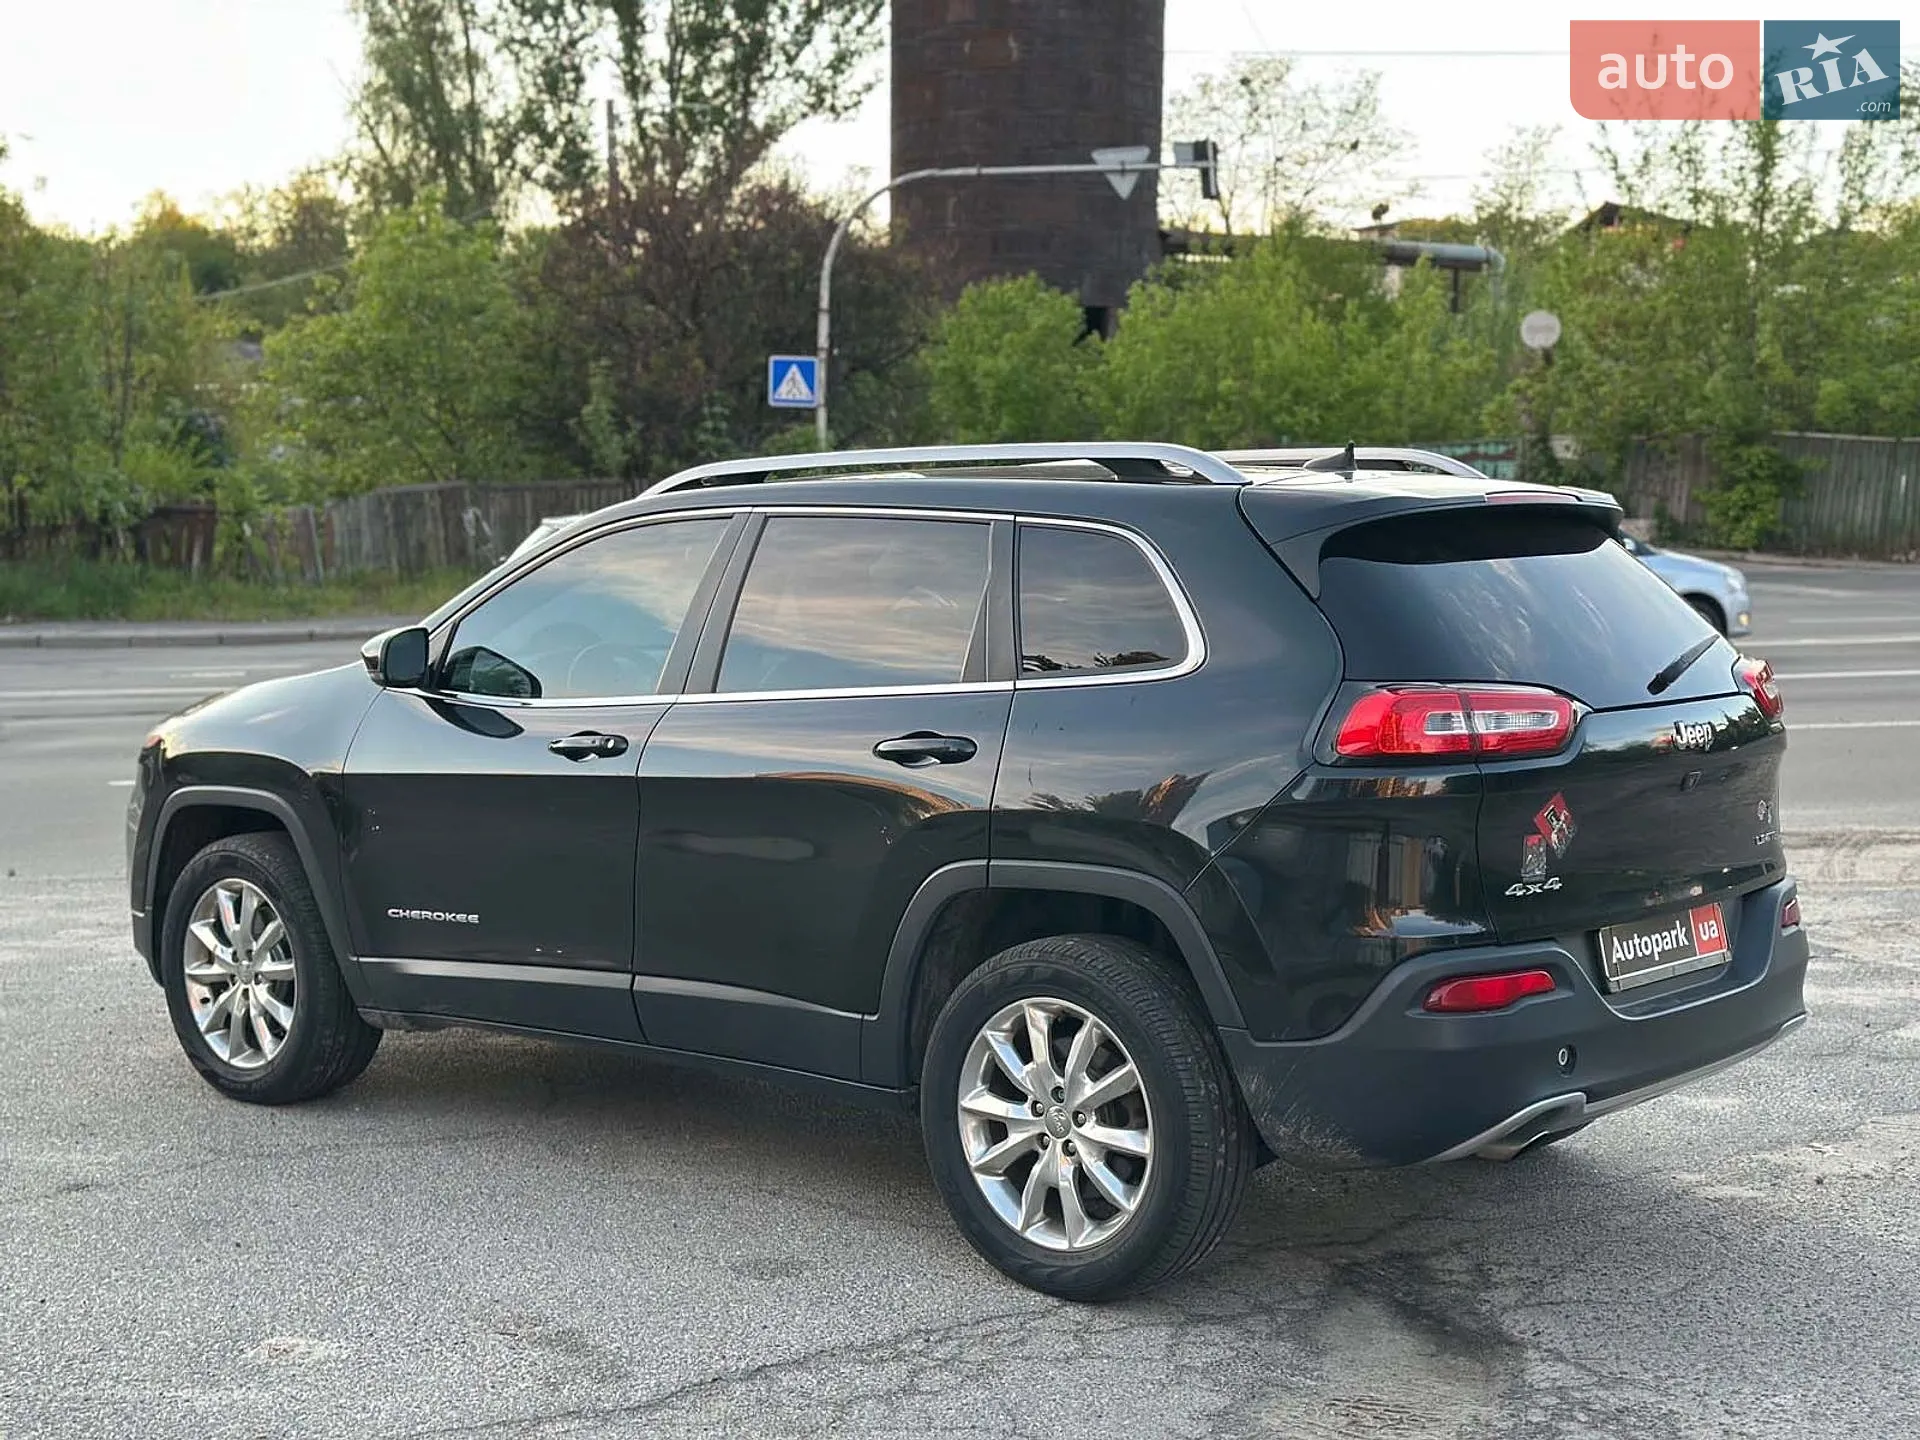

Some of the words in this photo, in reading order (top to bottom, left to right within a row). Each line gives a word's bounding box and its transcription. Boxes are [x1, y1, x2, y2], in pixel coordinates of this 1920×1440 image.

[1675, 722, 1712, 751] Jeep
[1505, 877, 1562, 896] 4x4
[387, 908, 480, 923] CHEROKEE
[1612, 920, 1690, 964] Autopark
[1698, 919, 1720, 942] ua
